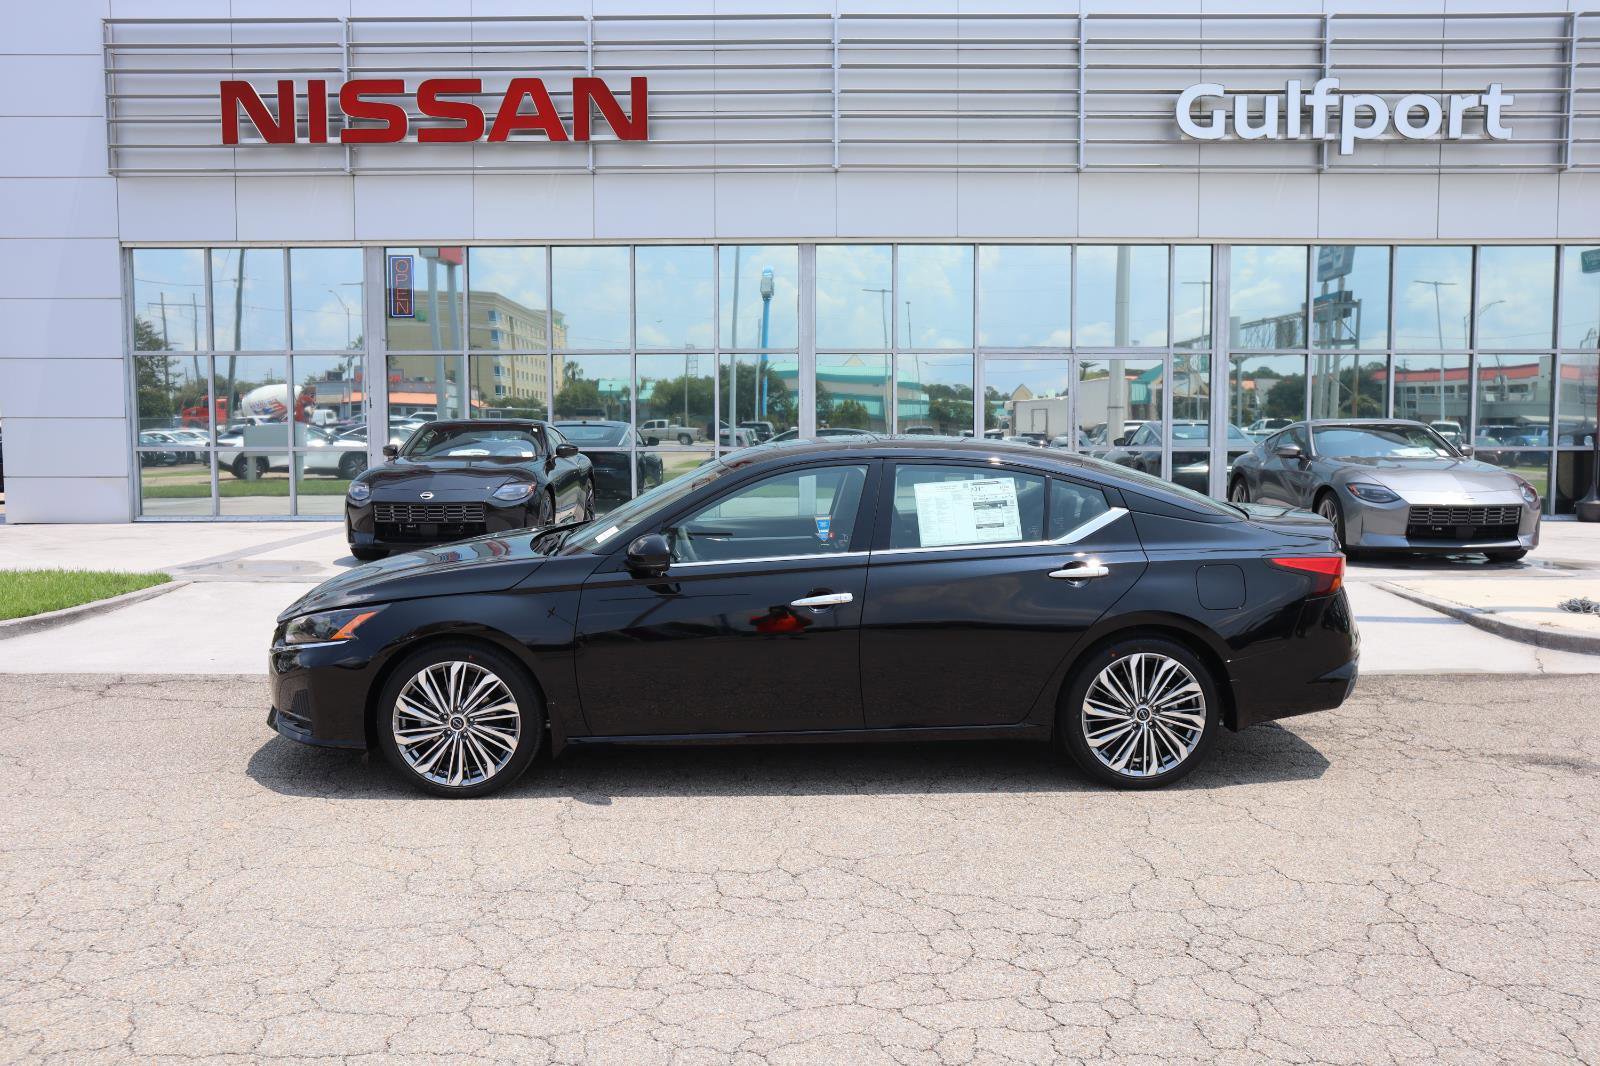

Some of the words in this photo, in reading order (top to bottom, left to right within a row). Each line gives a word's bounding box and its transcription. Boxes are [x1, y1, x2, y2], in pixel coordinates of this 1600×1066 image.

[220, 77, 648, 144] NISSAN
[1175, 77, 1514, 155] Gulfport
[395, 259, 409, 314] OPEN
